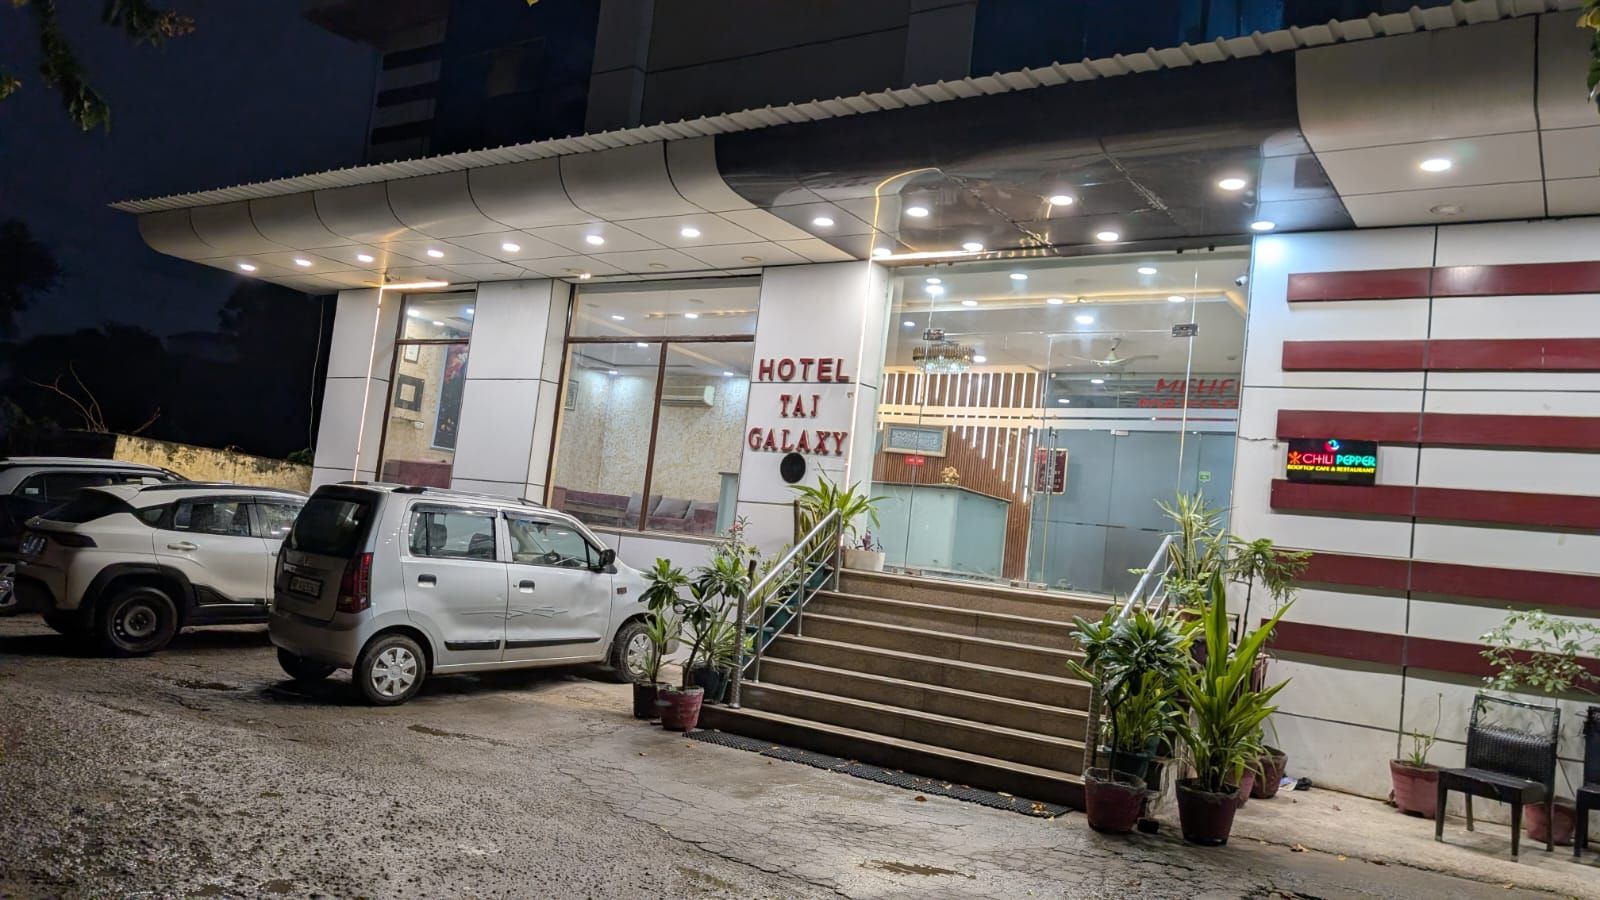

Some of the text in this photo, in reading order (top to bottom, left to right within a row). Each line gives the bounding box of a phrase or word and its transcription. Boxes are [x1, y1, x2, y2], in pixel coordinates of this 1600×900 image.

[758, 358, 850, 382] HOTEL
[780, 394, 820, 417] TAJ
[748, 428, 848, 456] GALAXY
[1303, 453, 1375, 466] CHILI PEPPER
